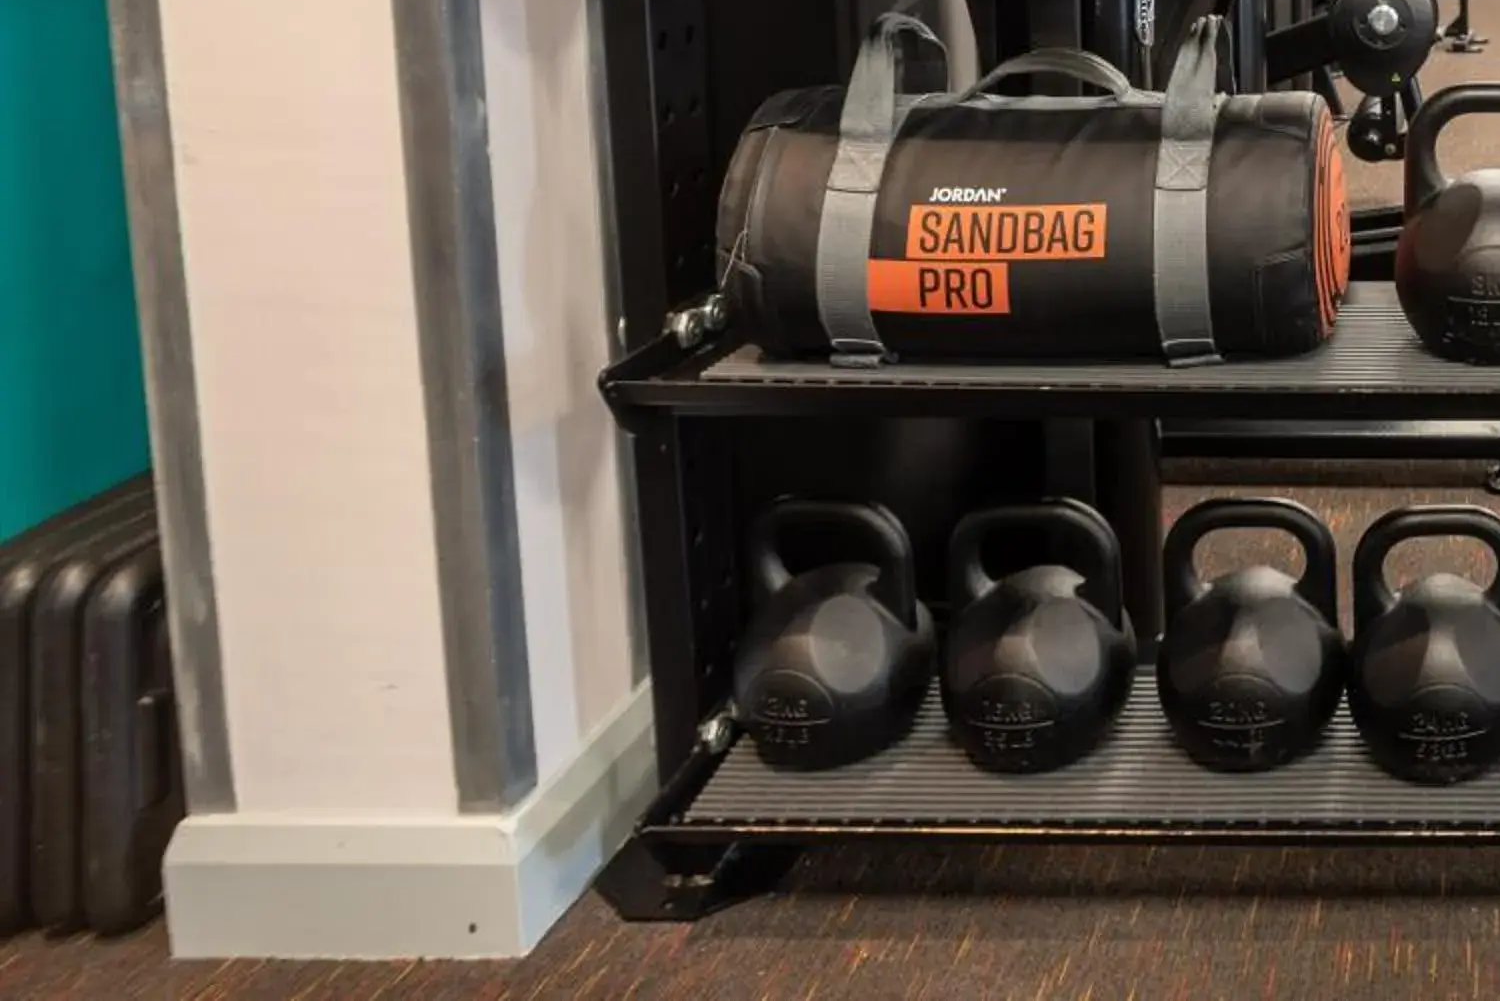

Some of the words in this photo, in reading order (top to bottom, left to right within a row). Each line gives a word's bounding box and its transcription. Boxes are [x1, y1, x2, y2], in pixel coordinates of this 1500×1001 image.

[929, 188, 1004, 202] JORDAN
[920, 210, 1095, 255] SANDBAG
[919, 268, 993, 309] PRO
